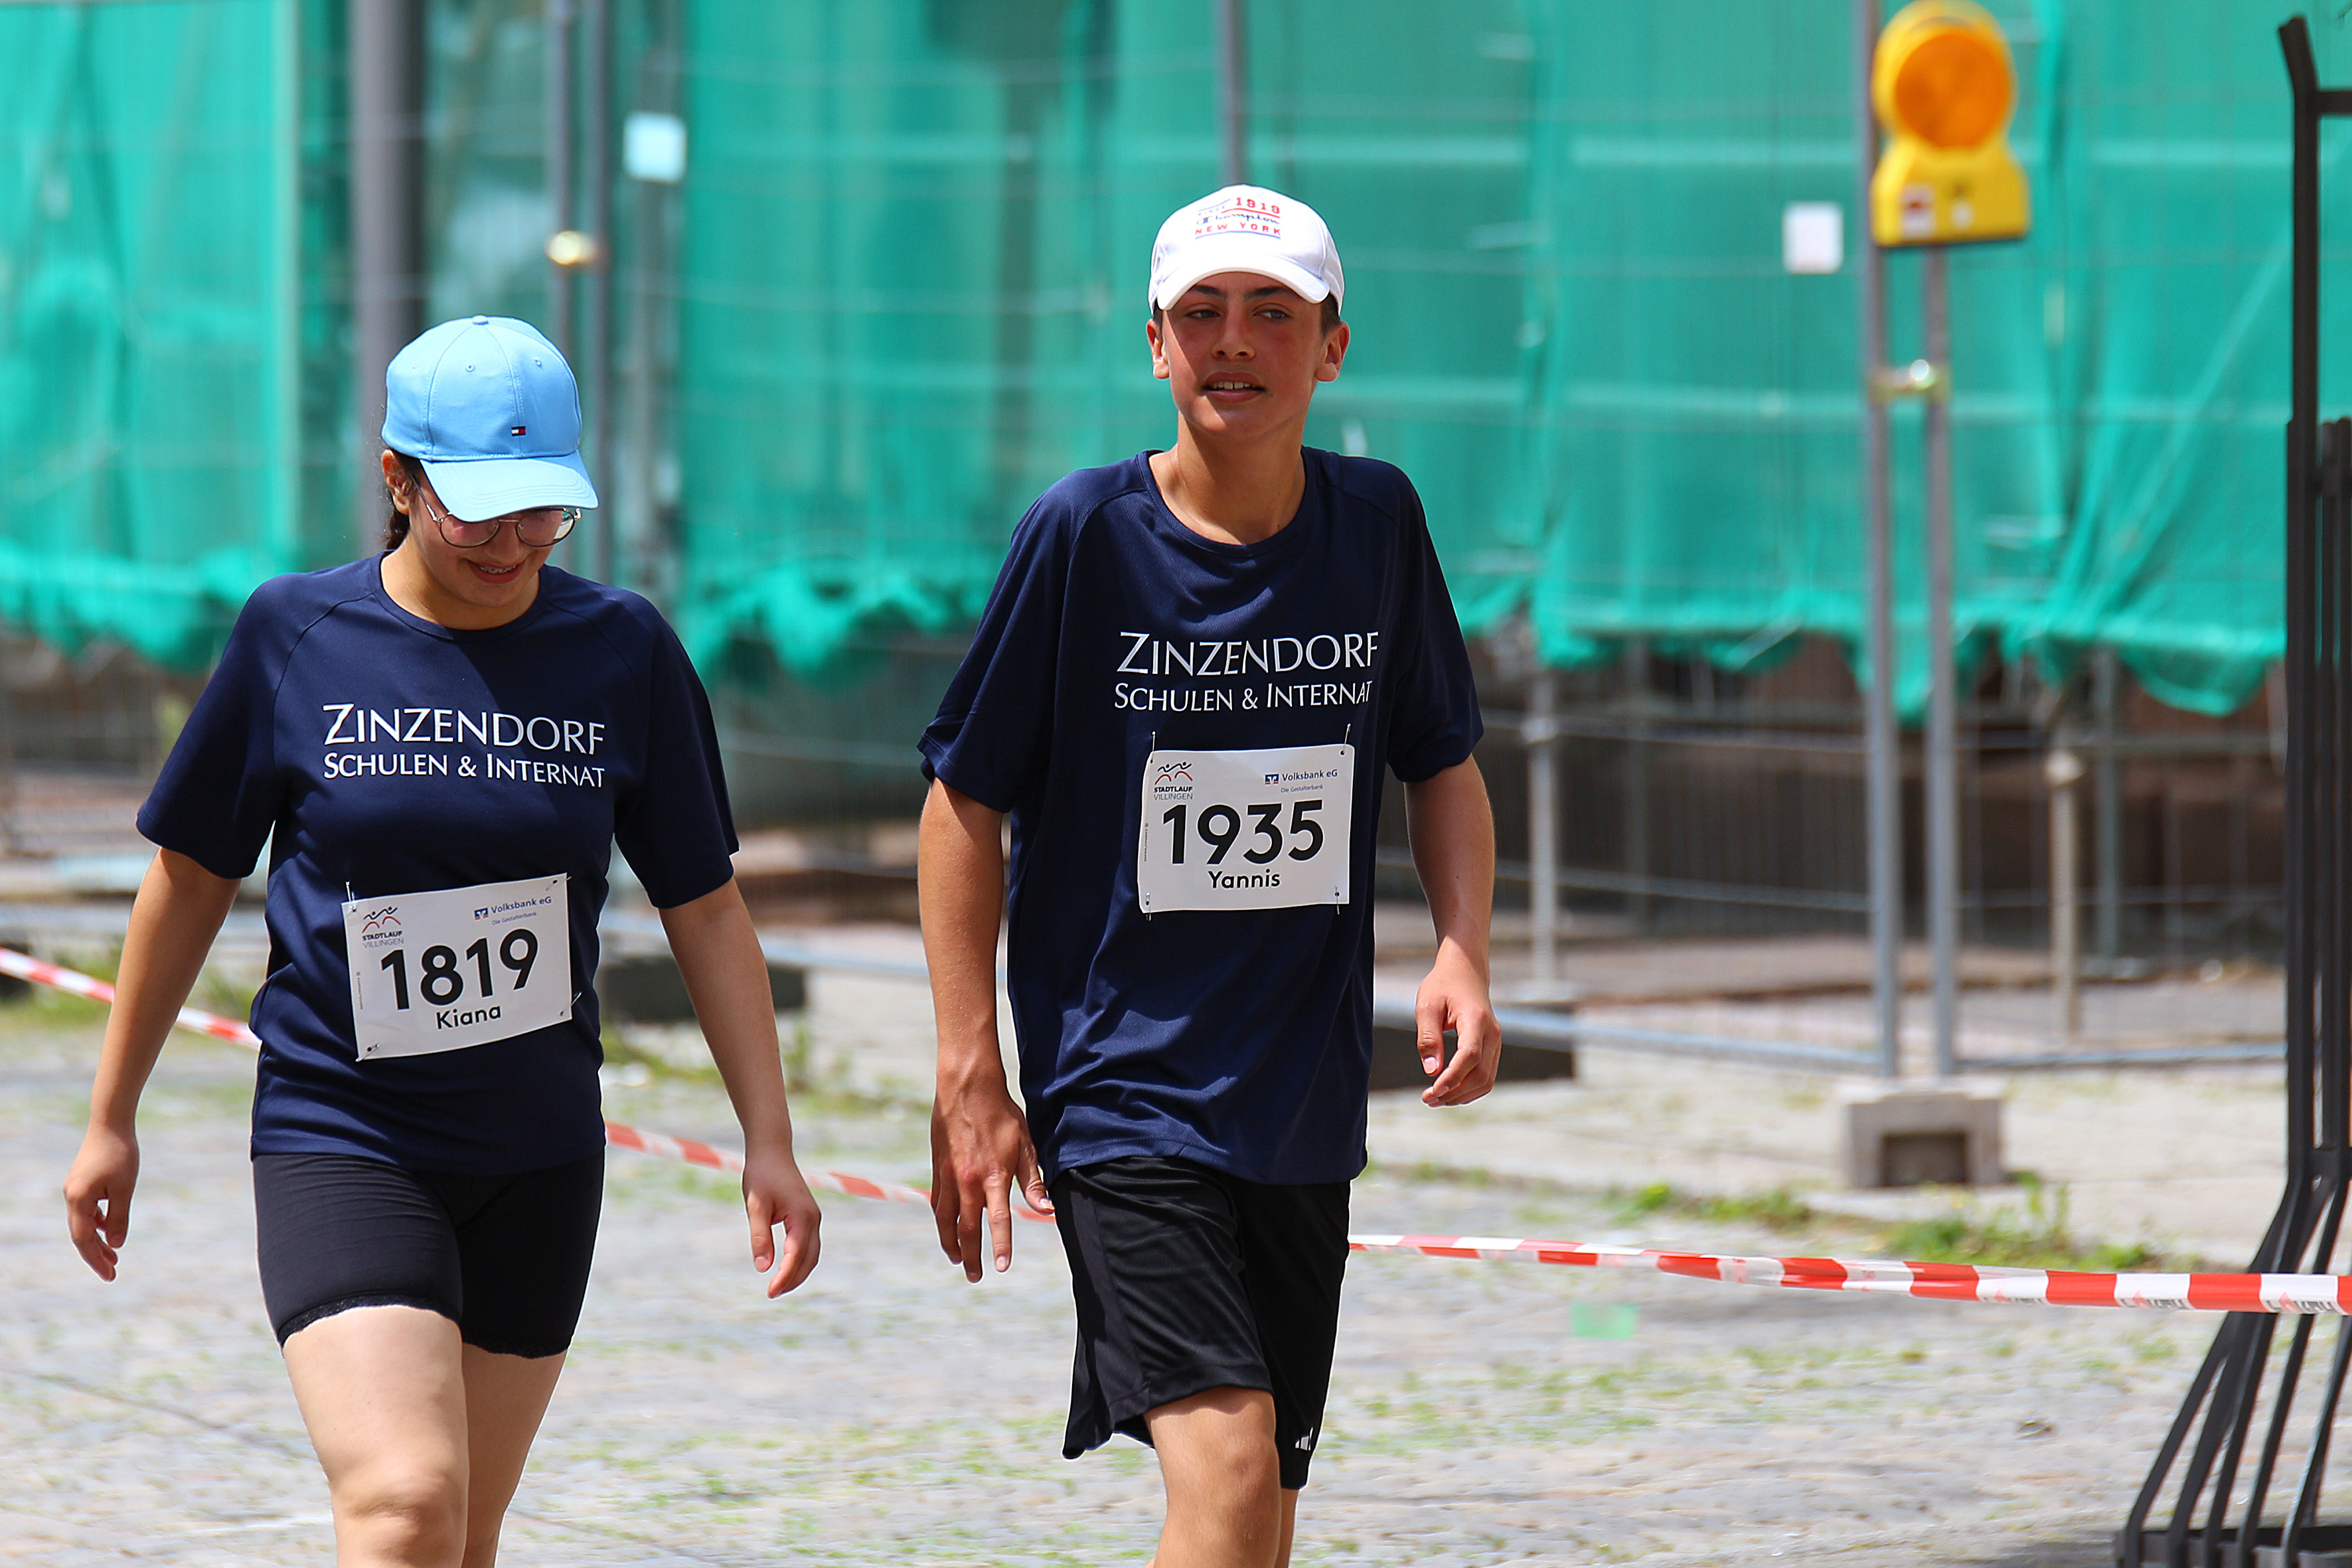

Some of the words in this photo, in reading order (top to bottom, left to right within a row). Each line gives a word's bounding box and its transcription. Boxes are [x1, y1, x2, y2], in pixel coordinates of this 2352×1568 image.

[1195, 224, 1227, 235] NEW
[1239, 222, 1281, 236] YORK
[1117, 631, 1379, 676] ZINZENDORF
[1115, 682, 1233, 712] SCHULEN
[1242, 688, 1259, 710] &
[1267, 680, 1372, 708] INTERNAT
[323, 703, 605, 755] ZINZENDORF
[323, 751, 448, 779] SCHULEN
[457, 755, 477, 777] &
[487, 753, 605, 788] INTERNAT
[1282, 770, 1324, 782] Volksbank
[1326, 769, 1338, 778] eG
[1163, 799, 1324, 865] 1935
[1208, 868, 1281, 889] Yannis
[491, 899, 537, 914] Volksbank
[539, 896, 552, 905] eG
[362, 931, 403, 941] STADTLAUF
[362, 938, 404, 949] VILLINGEN
[380, 929, 538, 1011] 1819
[436, 1005, 502, 1030] Kiana
